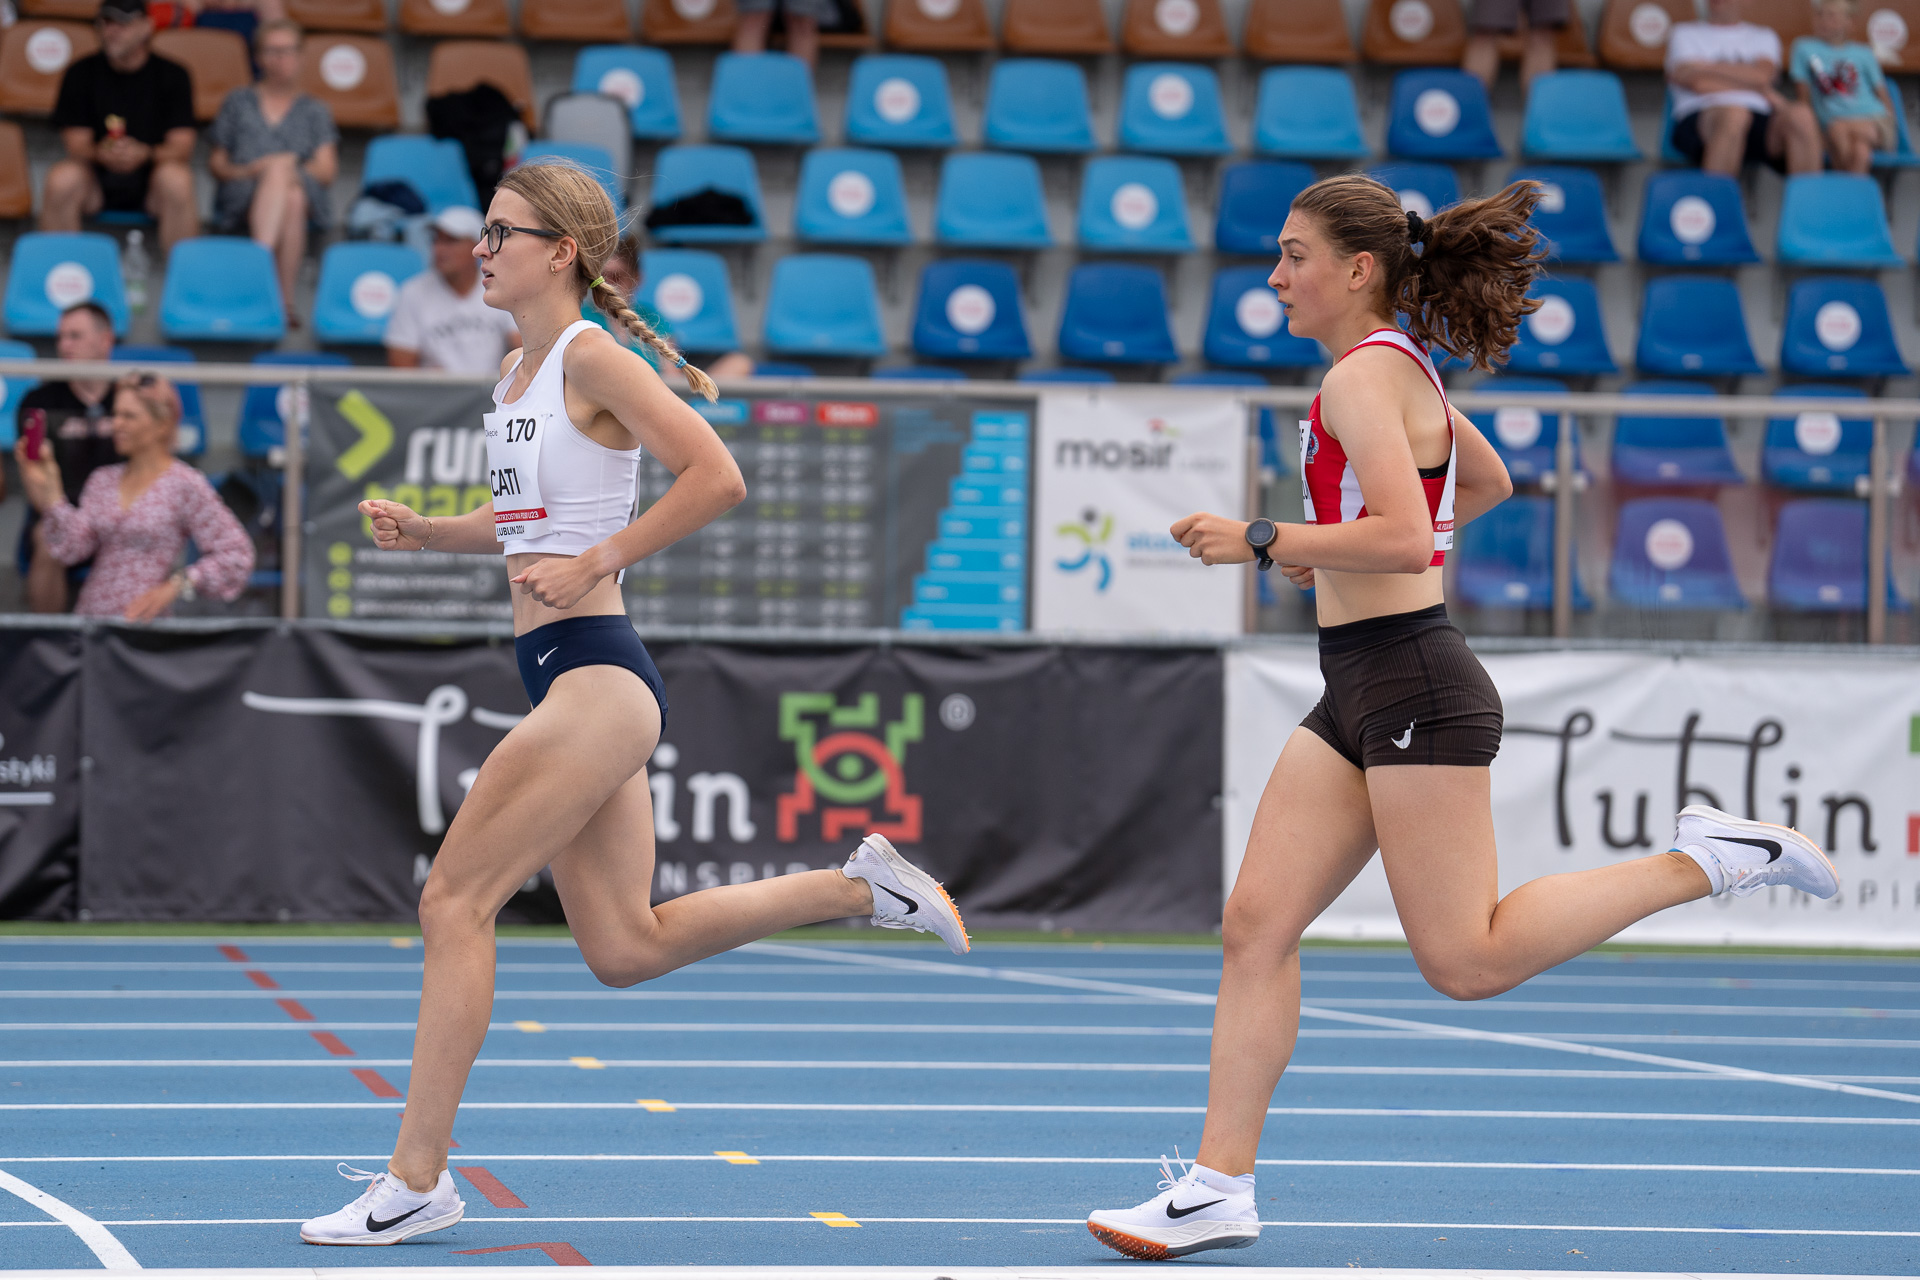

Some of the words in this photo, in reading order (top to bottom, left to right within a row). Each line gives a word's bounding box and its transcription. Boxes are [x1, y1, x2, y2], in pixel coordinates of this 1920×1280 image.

[506, 418, 536, 443] 170
[490, 467, 521, 497] CATI
[497, 526, 516, 536] LUBLIN
